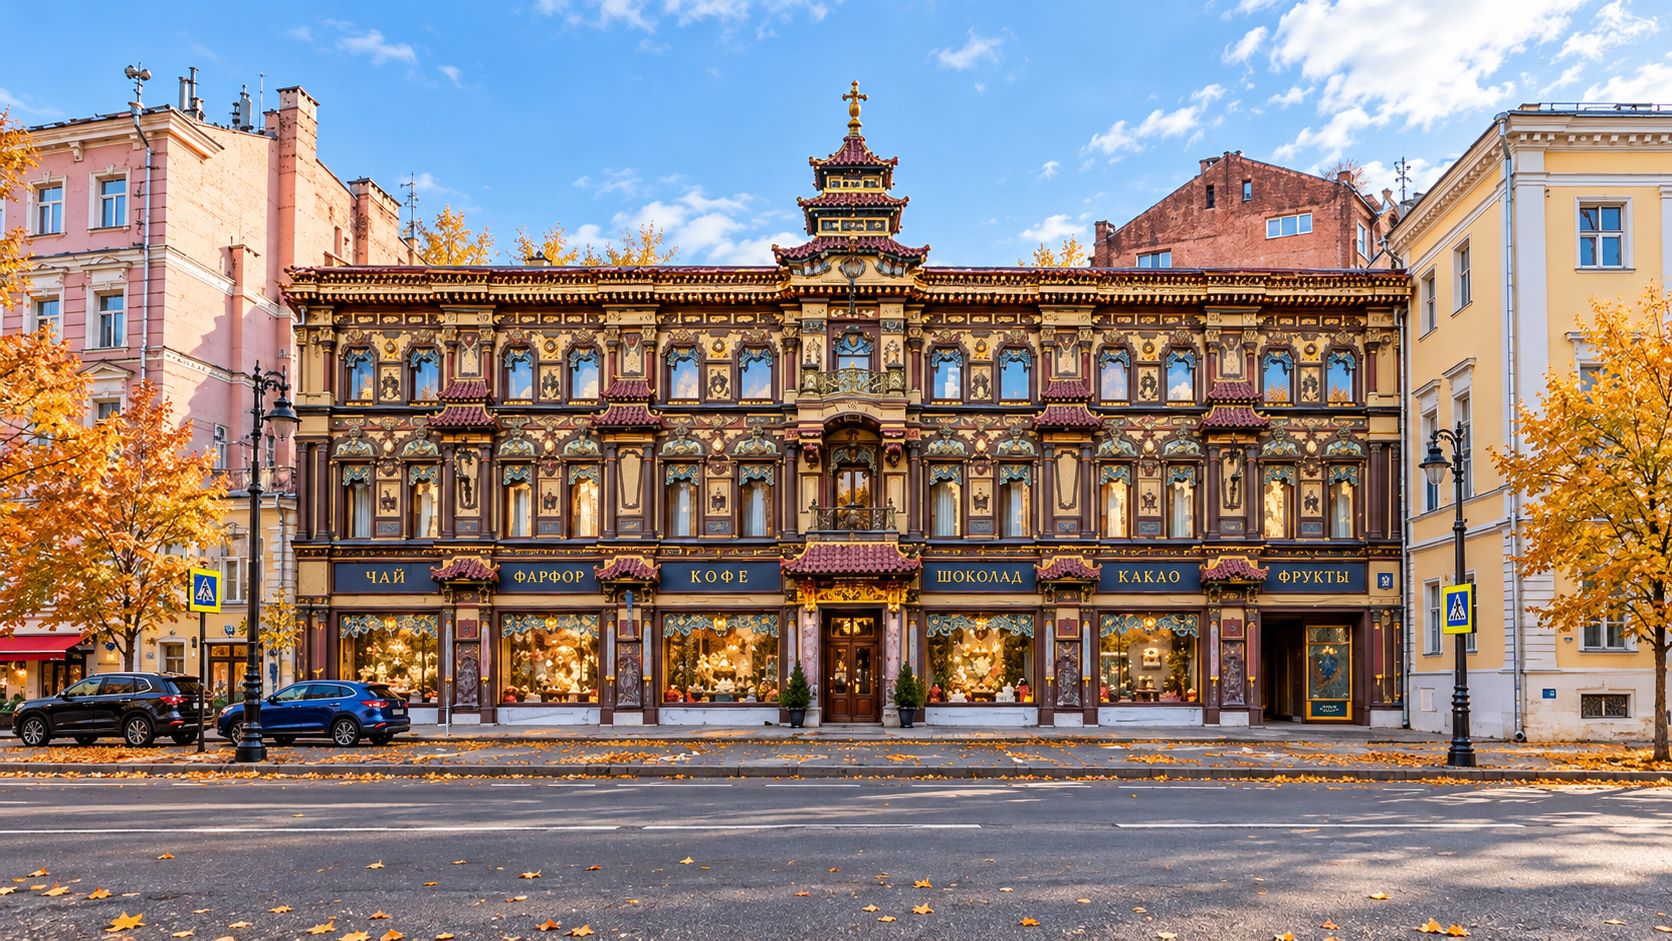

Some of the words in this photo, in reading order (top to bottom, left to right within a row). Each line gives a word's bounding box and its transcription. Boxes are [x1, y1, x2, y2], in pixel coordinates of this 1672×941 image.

[365, 567, 405, 584] ЧАЙ
[513, 569, 585, 584] ФАРФОР
[690, 569, 748, 584] КОФЕ
[937, 570, 1023, 584] ШОКОЛАД
[1118, 570, 1181, 583] КАКАО
[1278, 569, 1350, 584] ФРУКТЫ
